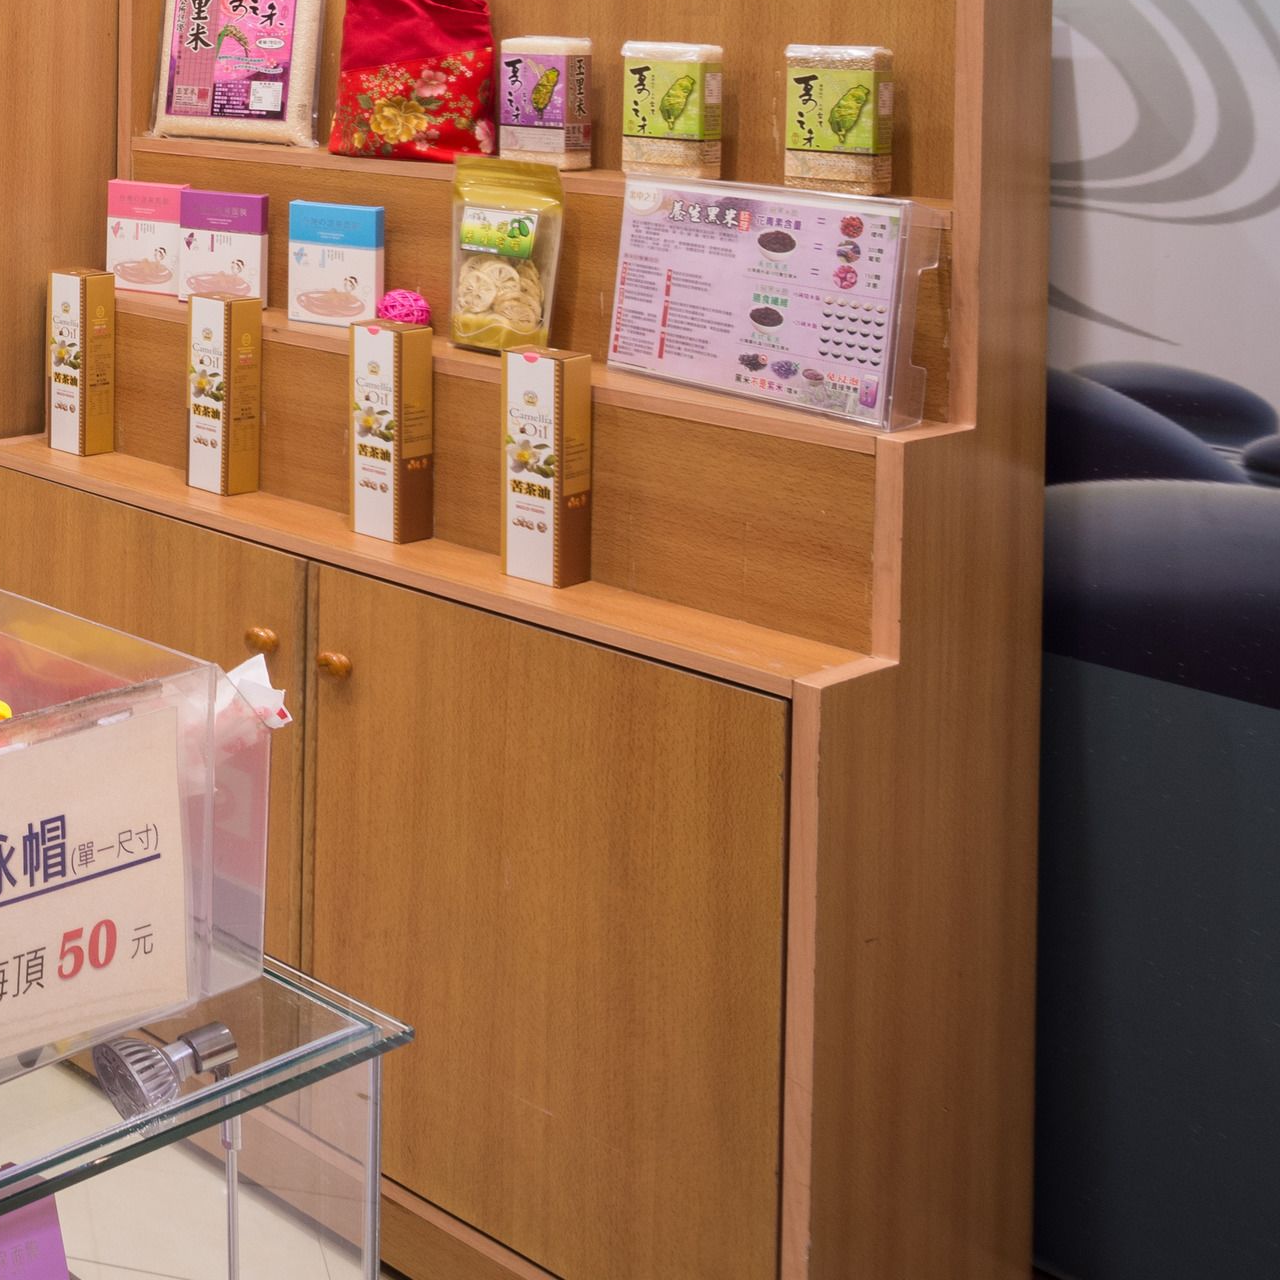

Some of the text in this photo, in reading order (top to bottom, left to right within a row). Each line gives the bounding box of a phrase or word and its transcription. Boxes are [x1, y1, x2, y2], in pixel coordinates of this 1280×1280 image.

[669, 200, 739, 228] 養生黑米
[61, 325, 76, 339] Oil
[203, 355, 219, 369] Oil
[368, 390, 388, 406] Oil
[509, 407, 553, 425] Camellia
[523, 422, 548, 440] Oil
[70, 823, 159, 875] (單一尺寸)
[57, 919, 117, 980] 50
[131, 924, 154, 959] 元
